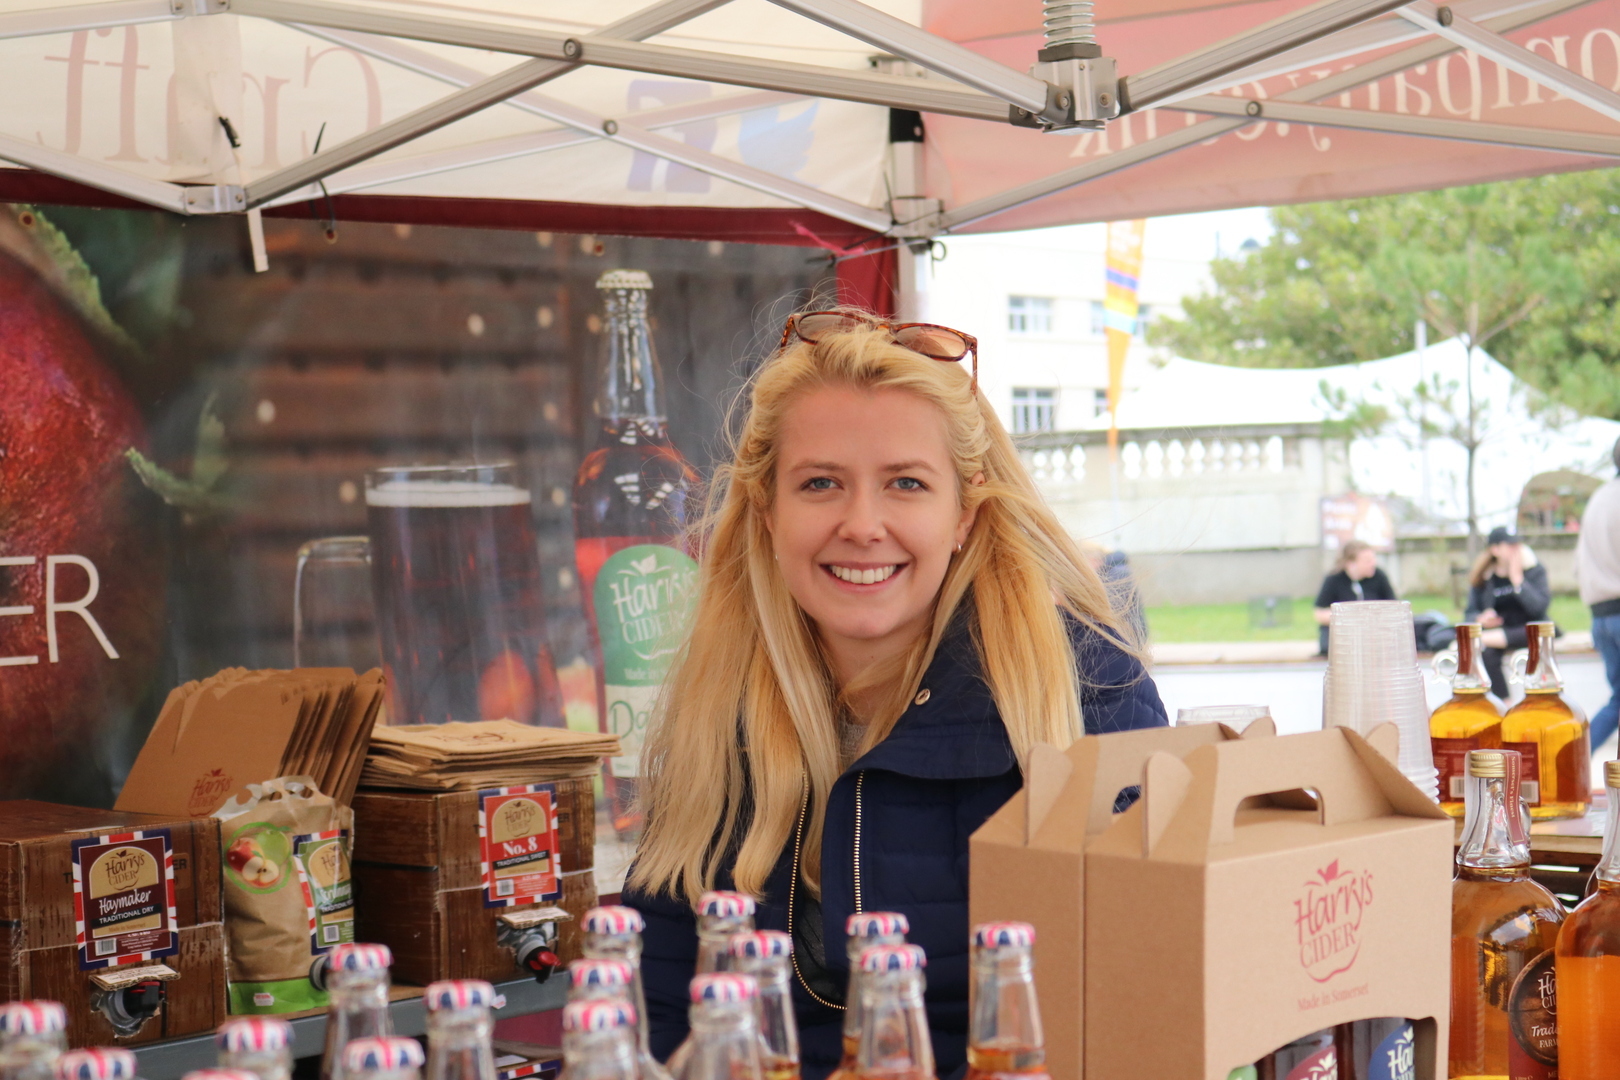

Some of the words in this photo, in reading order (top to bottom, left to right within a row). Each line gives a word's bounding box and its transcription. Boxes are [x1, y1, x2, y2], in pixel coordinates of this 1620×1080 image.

[502, 840, 526, 857] No.
[528, 836, 538, 852] 8
[105, 853, 145, 877] Harry's
[496, 856, 530, 868] TRADITIONAL
[108, 870, 137, 887] CIDER
[99, 889, 151, 915] Haymaker
[1293, 869, 1374, 945] Harry's
[99, 910, 141, 924] TRADITIONAL
[142, 906, 154, 915] DRY
[1300, 922, 1356, 969] CIDER
[1297, 992, 1320, 1012] Made
[1322, 992, 1331, 1006] in
[1331, 983, 1370, 1004] Somerset
